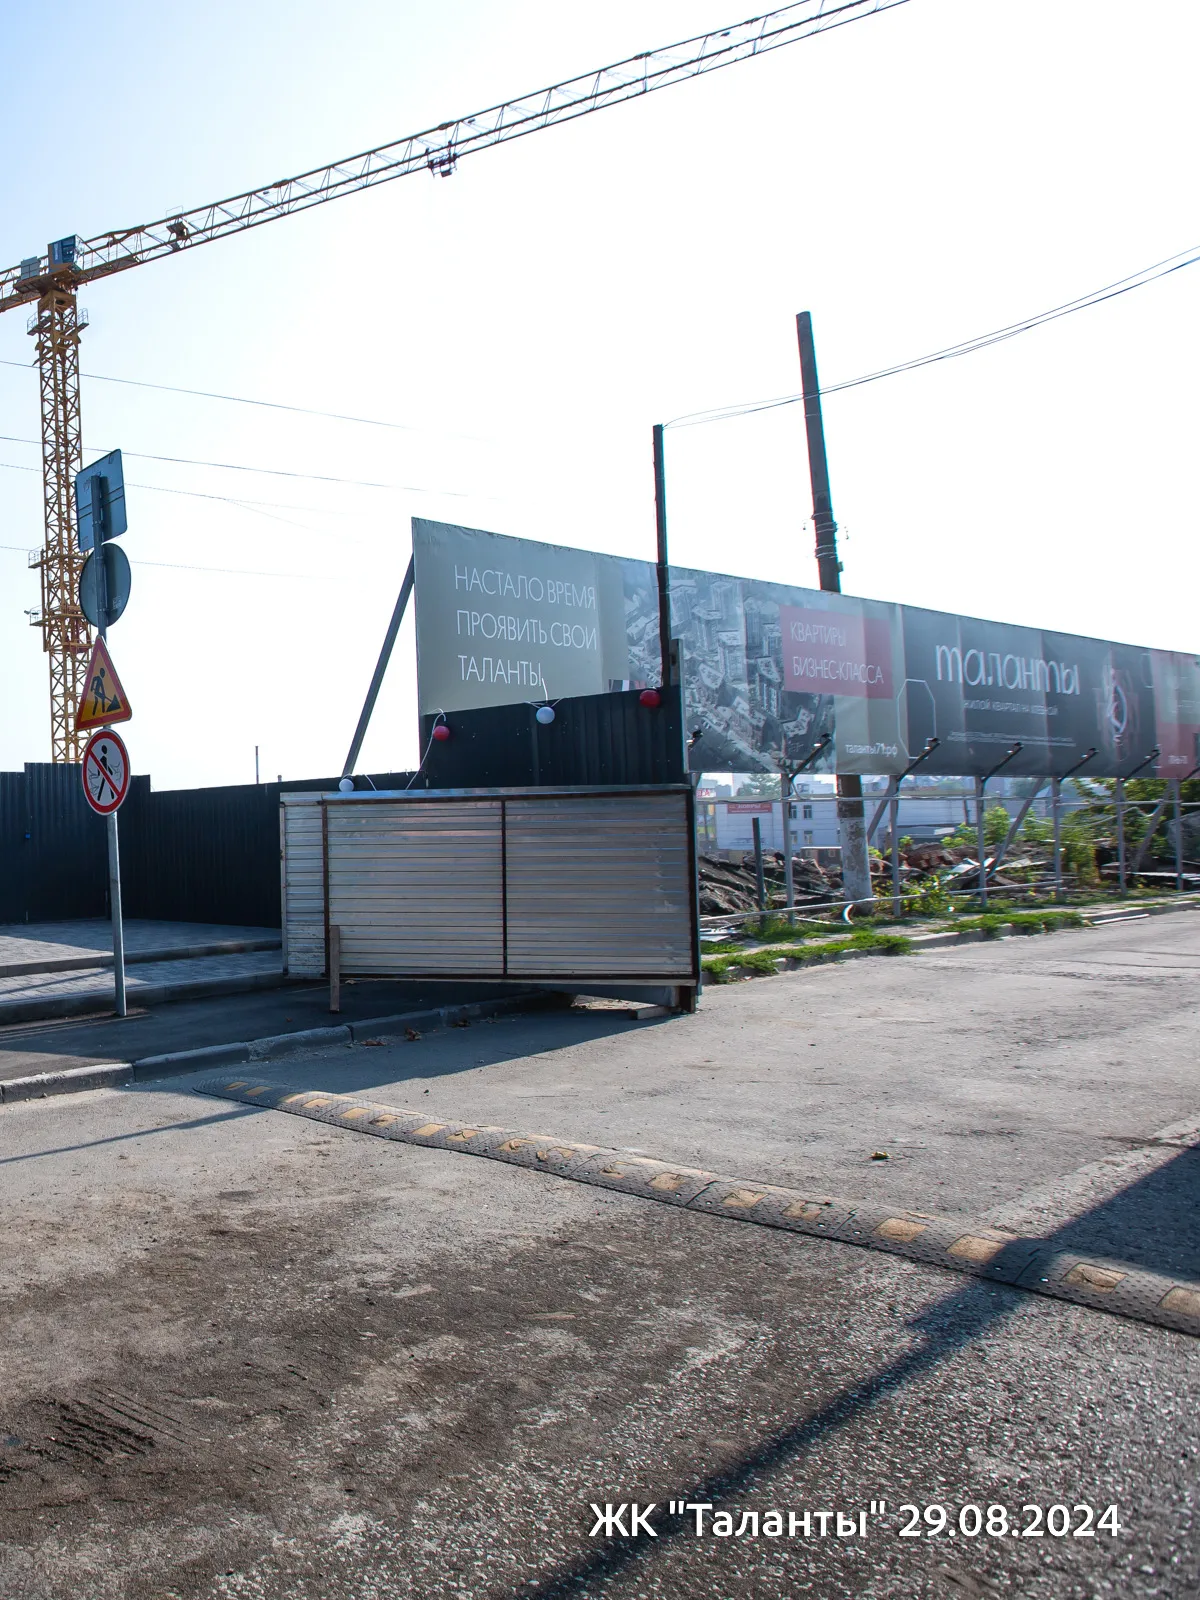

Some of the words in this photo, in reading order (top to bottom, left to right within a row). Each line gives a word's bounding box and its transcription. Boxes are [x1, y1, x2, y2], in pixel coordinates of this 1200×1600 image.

[454, 564, 544, 602] НАСТАЛО
[546, 579, 597, 610] ВРЕМЯ
[456, 609, 548, 645] ПРОЯВИТЬ
[549, 622, 598, 651] СВОИ
[790, 621, 847, 648] КВАРТИРЫ
[457, 654, 543, 687] ТАЛАНТЫ
[792, 656, 885, 685] БИЗНЕС-КЛАССА
[935, 644, 1081, 696] таланты
